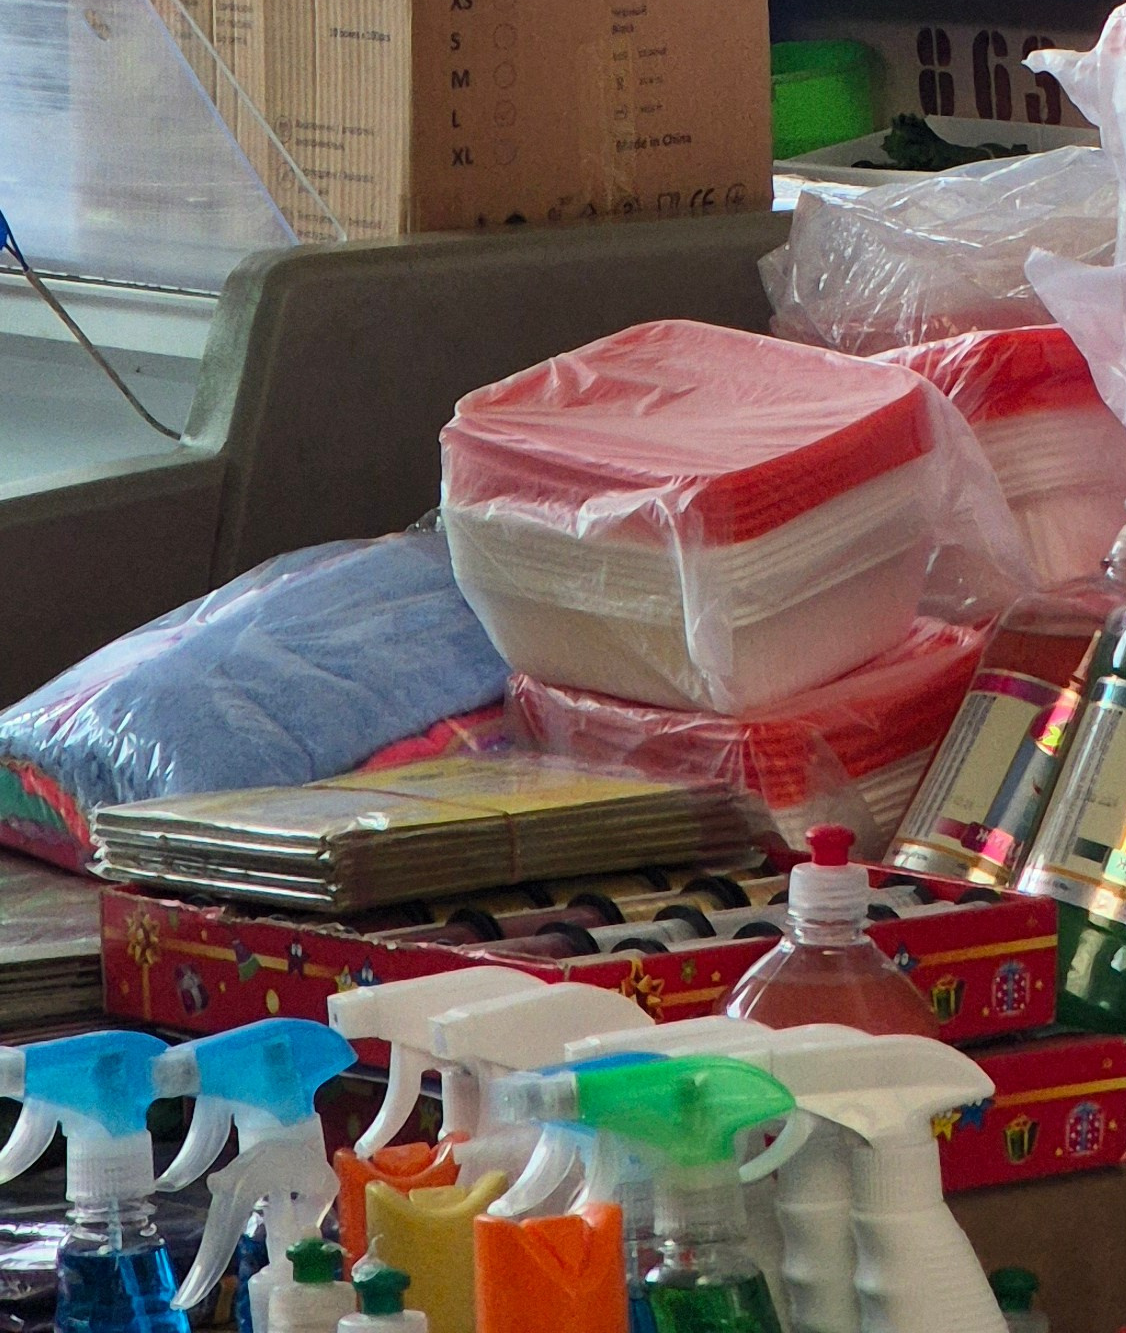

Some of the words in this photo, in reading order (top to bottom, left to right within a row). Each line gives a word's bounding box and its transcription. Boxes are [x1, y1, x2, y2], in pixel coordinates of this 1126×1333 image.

[451, 33, 461, 51] S
[452, 69, 471, 89] M
[452, 110, 462, 129] L
[452, 147, 474, 167] XL
